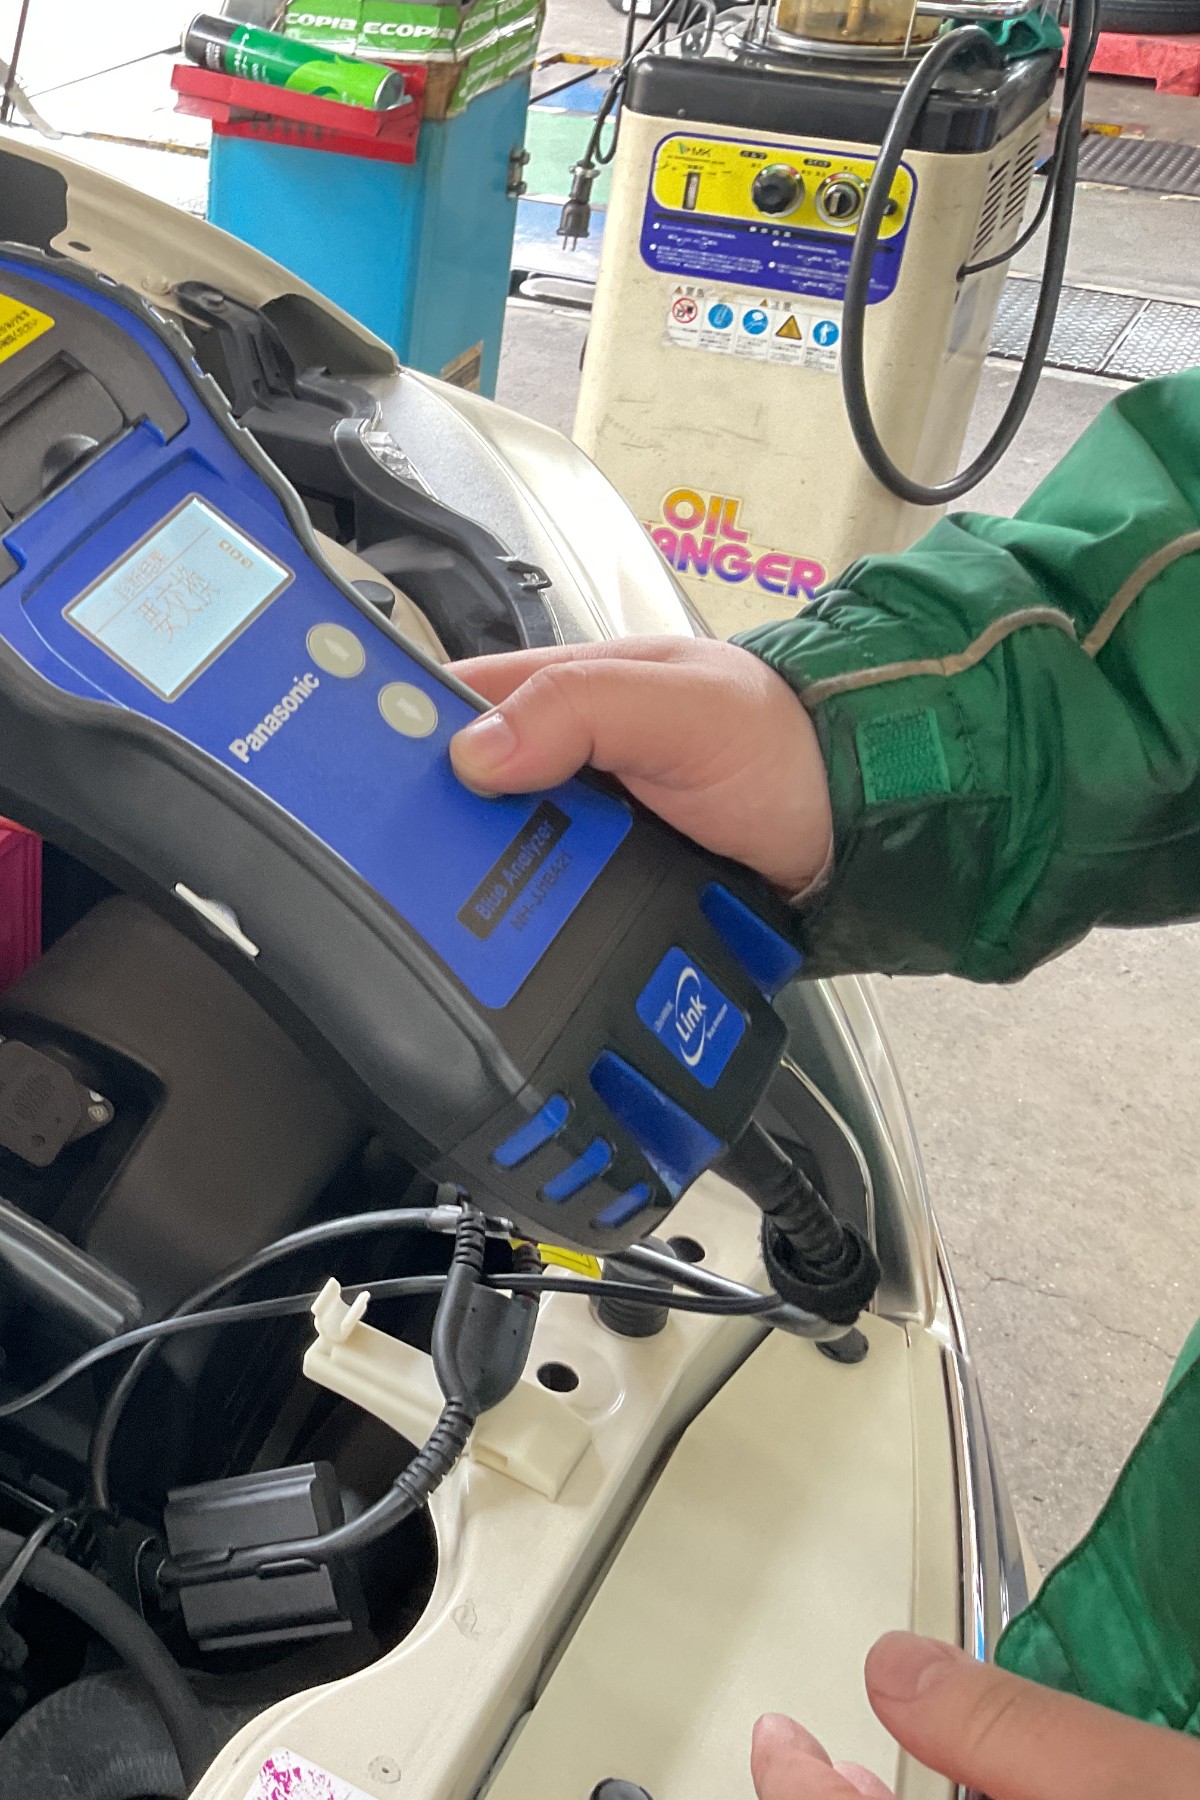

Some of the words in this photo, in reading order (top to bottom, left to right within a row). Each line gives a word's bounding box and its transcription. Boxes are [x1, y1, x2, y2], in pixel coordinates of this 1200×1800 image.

[285, 13, 357, 31] COPIA
[663, 489, 749, 542] OIL
[644, 523, 826, 601] ANGER
[133, 565, 221, 643] 要交換
[228, 672, 320, 763] Panasonic
[474, 882, 507, 920] Blue
[502, 818, 555, 884] Analyzer
[676, 993, 707, 1041] Link
